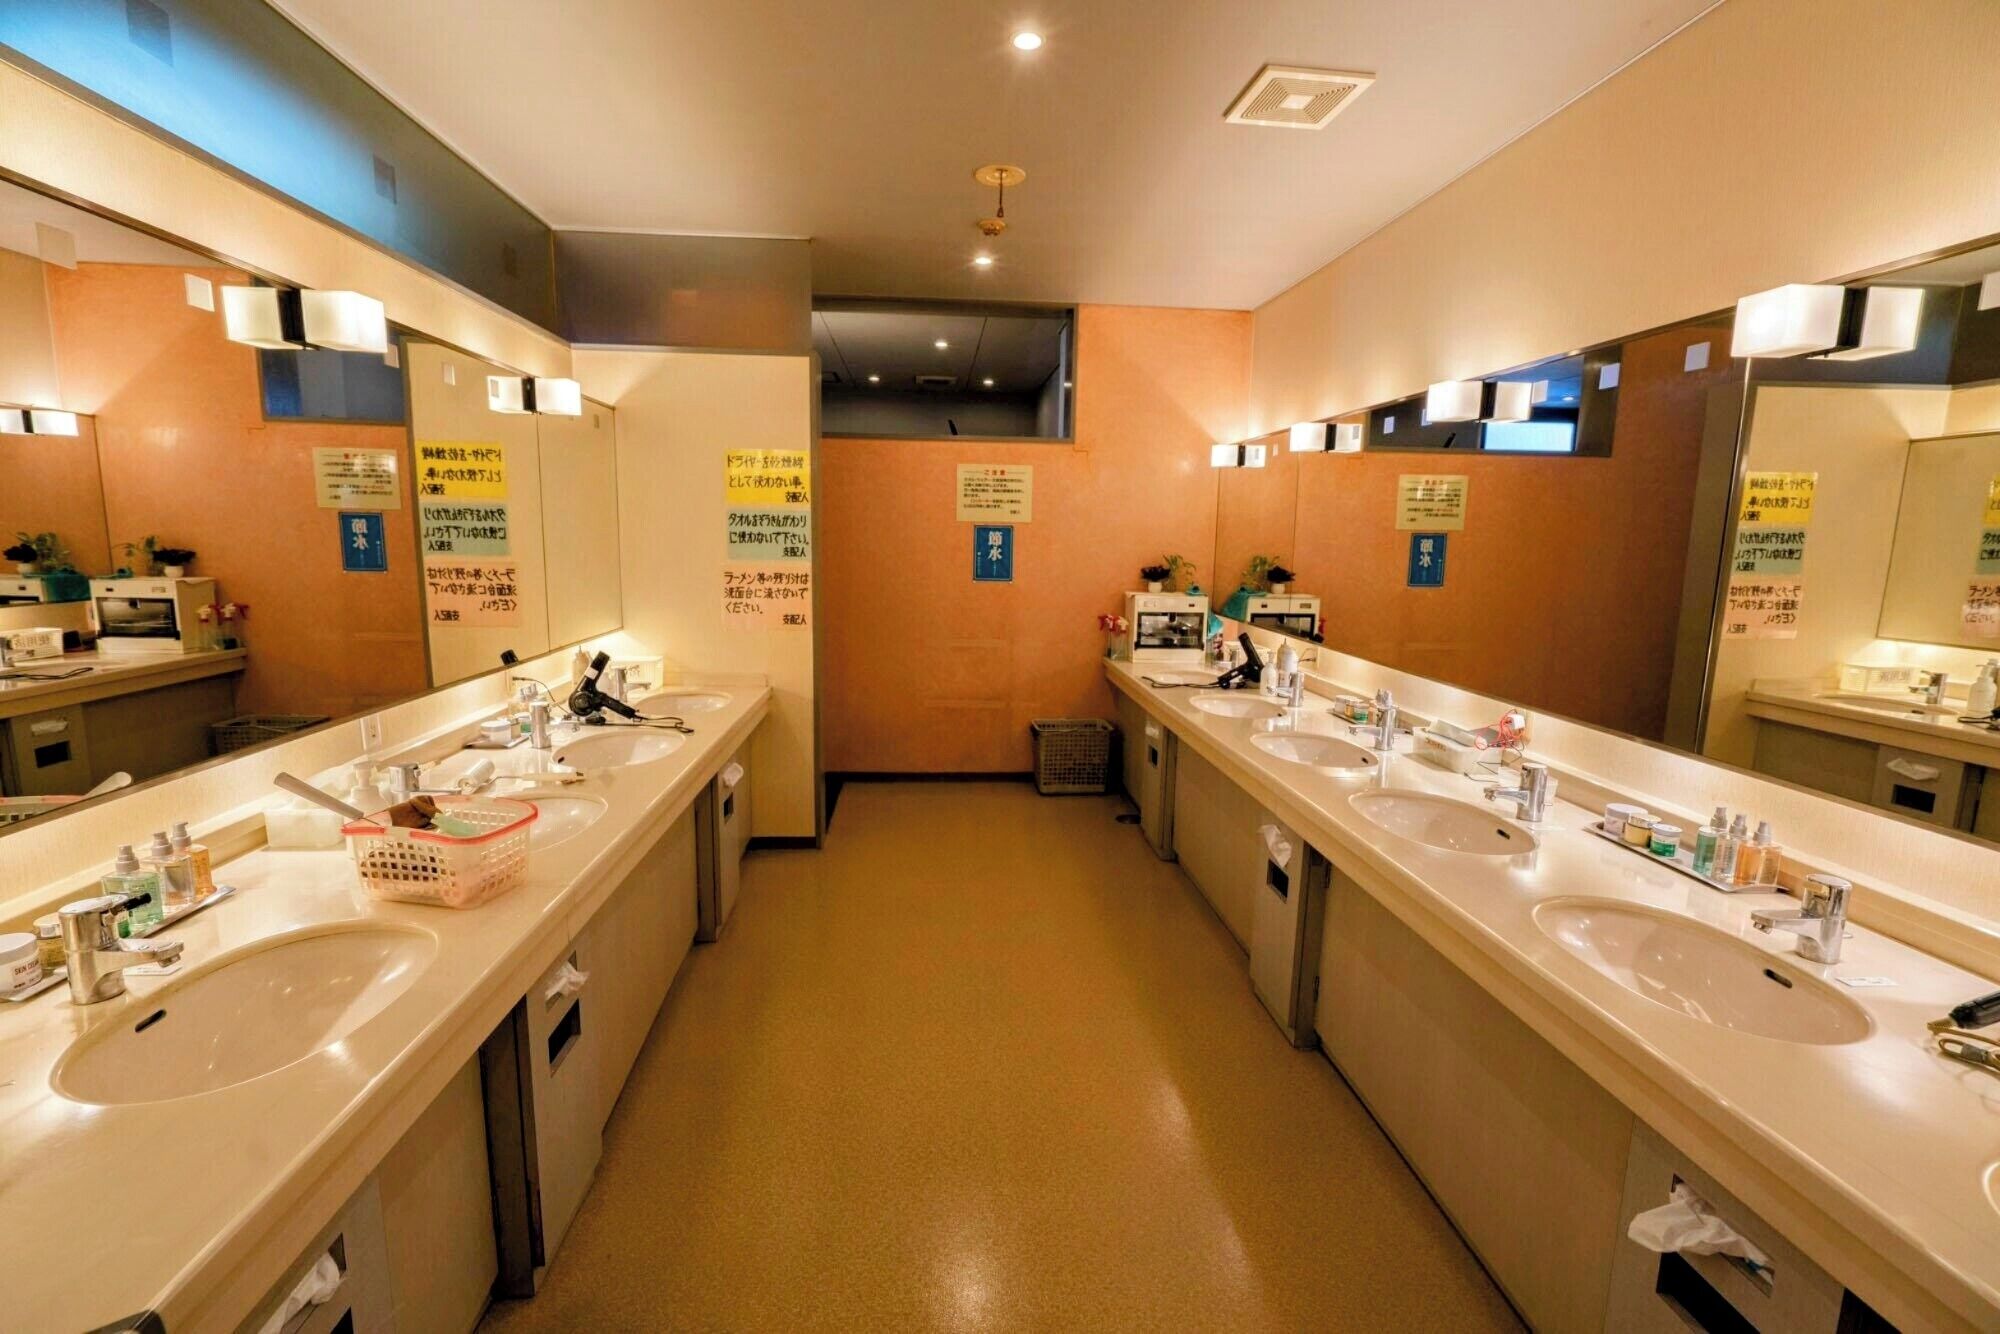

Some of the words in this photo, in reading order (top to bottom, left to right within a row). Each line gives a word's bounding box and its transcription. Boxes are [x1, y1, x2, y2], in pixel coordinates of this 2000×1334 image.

[785, 491, 809, 503] 支配人
[783, 546, 807, 558] 支配人
[723, 571, 809, 585] ラーメン等の残り汁は
[724, 587, 808, 600] 洗面台に流さないで
[782, 614, 807, 625] 支配人
